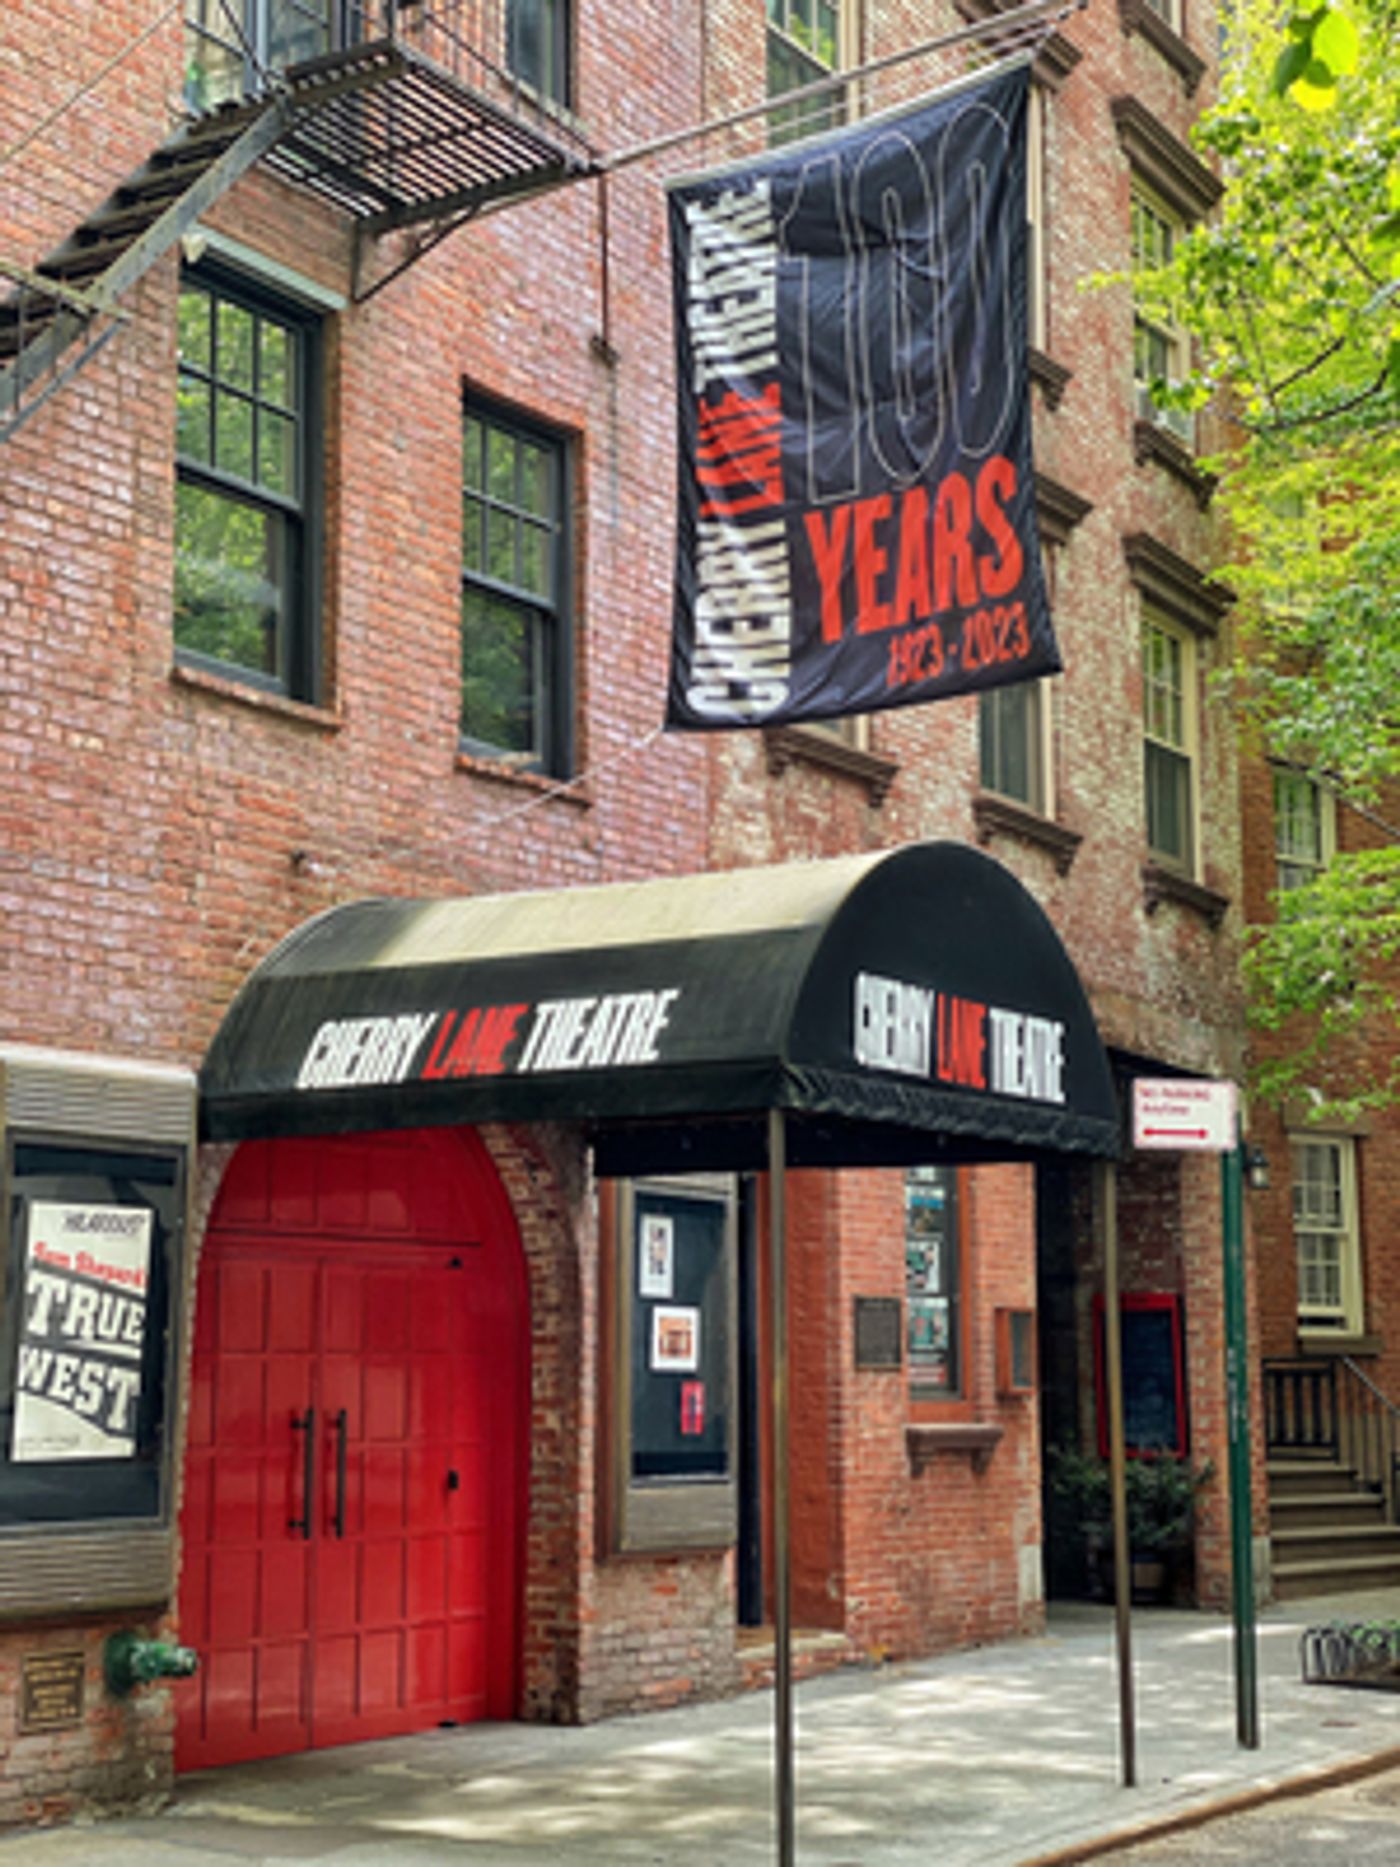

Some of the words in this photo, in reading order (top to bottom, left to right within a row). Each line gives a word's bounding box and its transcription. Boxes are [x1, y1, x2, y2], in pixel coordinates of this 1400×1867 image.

[685, 177, 779, 394] THEATRE
[695, 382, 785, 518] LANE
[804, 456, 1024, 645] YEARS
[686, 517, 792, 719] CHERRY
[296, 1012, 439, 1090] CHERRY
[420, 1003, 529, 1081] LANE
[517, 988, 680, 1073] THEATRE
[854, 972, 935, 1078] CHERRY
[937, 992, 987, 1090] LANE
[989, 1006, 1066, 1104] THEATRE
[26, 1270, 147, 1345] TRUE
[18, 1345, 141, 1431] WEST
